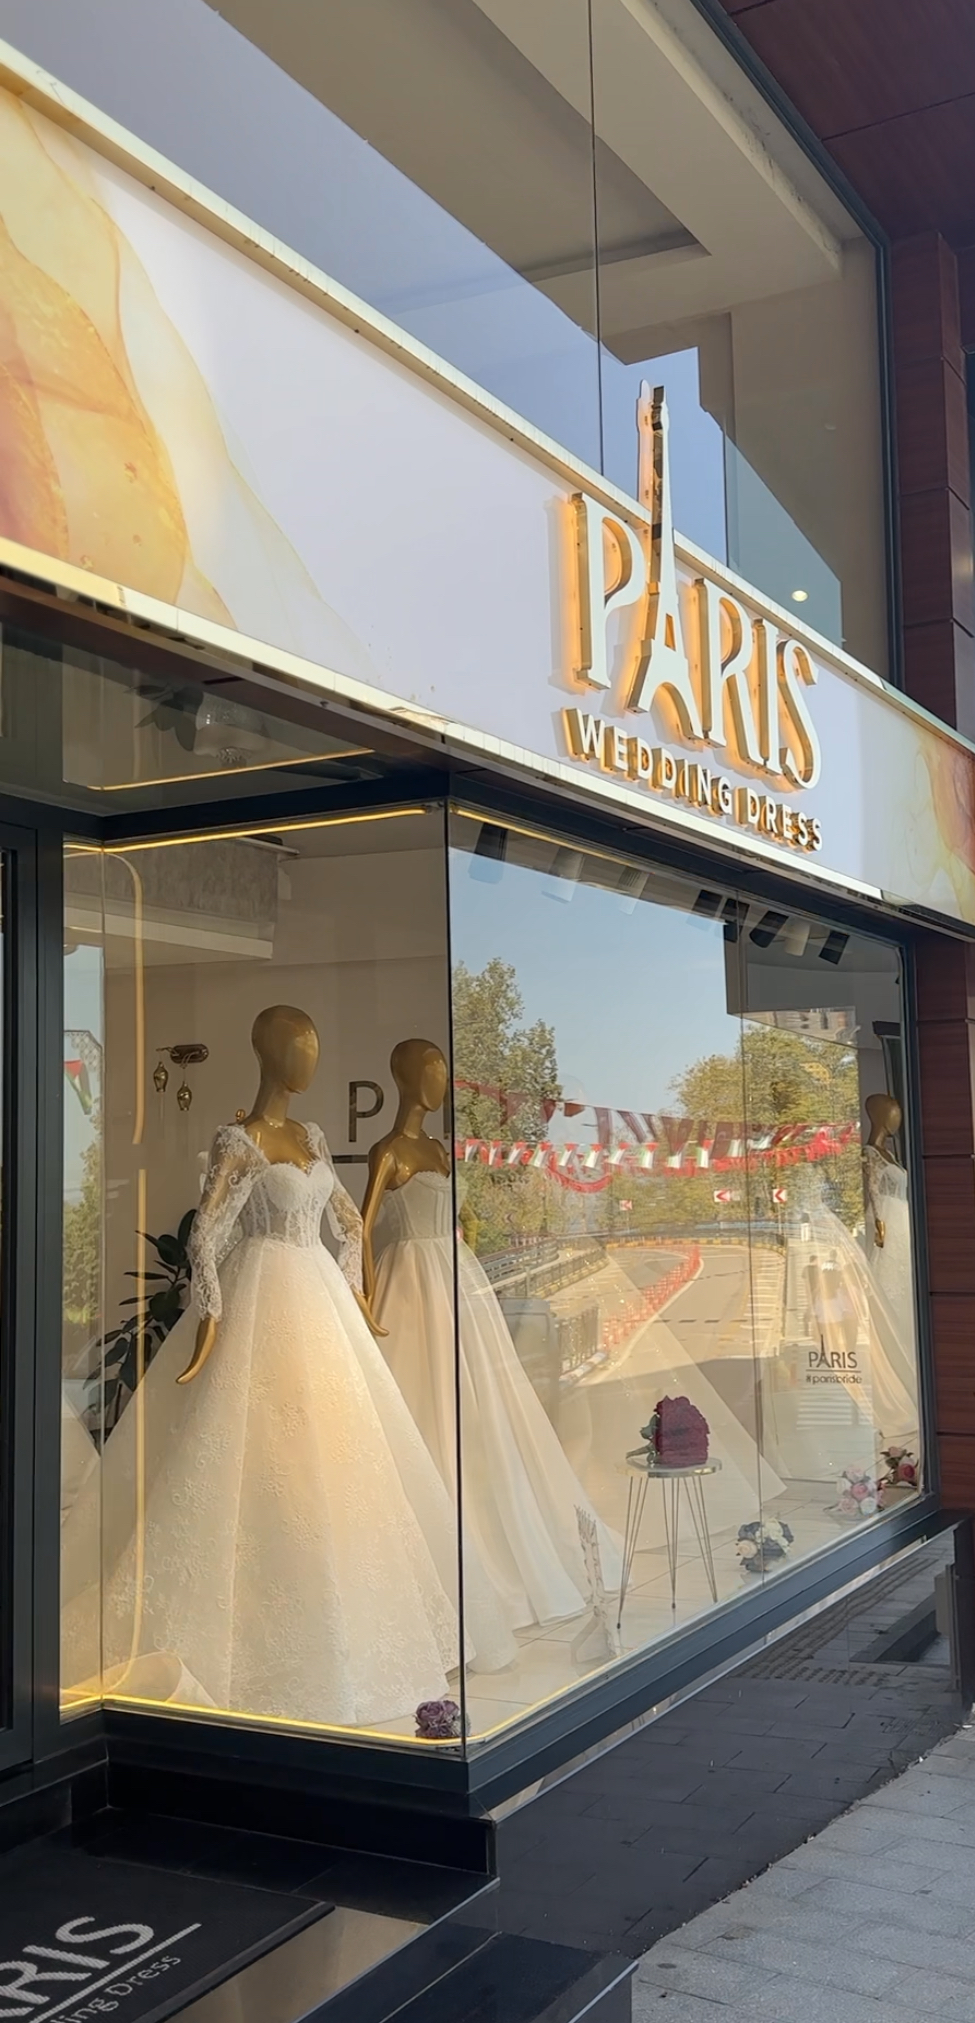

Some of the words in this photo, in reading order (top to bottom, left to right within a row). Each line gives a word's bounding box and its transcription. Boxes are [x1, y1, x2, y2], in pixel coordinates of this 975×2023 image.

[571, 380, 822, 790] PARIS
[567, 707, 733, 816] WEDDING
[739, 786, 823, 852] DRESS
[805, 1374, 862, 1385] #parisbride
[808, 1334, 858, 1369] PARIS
[0, 1916, 154, 2018] RIS
[103, 1955, 181, 1996] Dress
